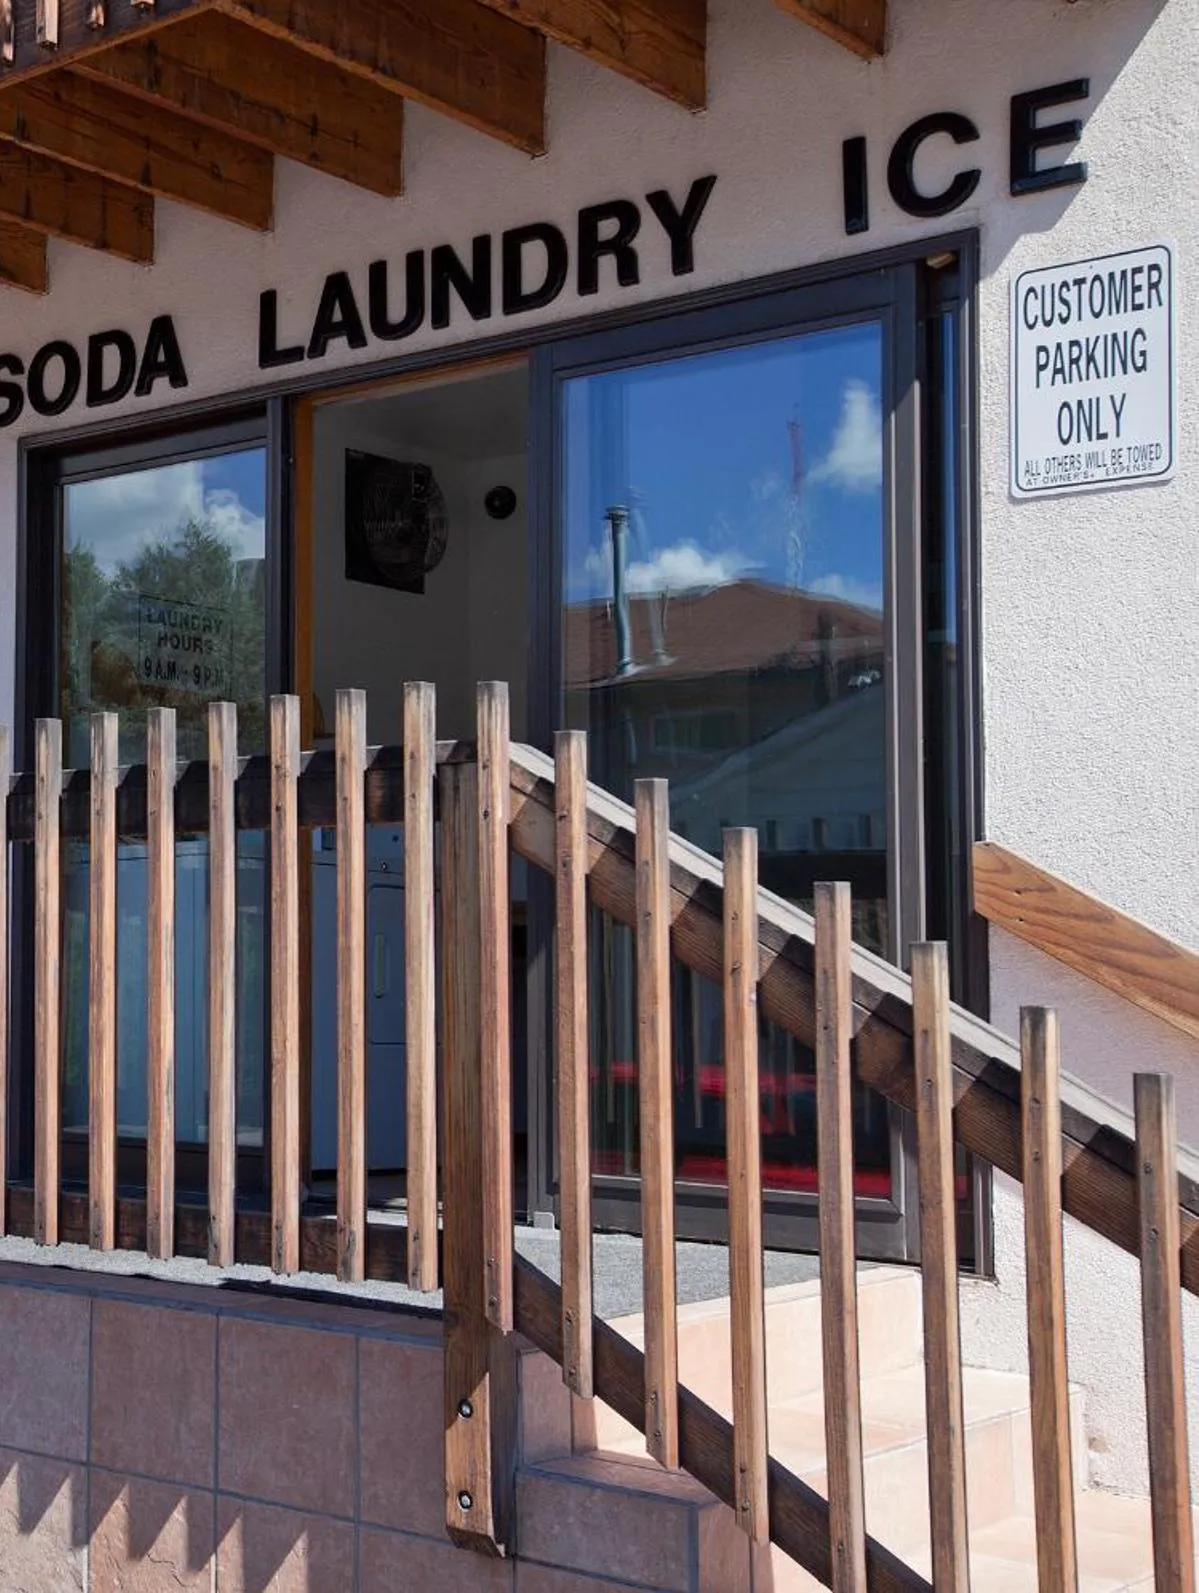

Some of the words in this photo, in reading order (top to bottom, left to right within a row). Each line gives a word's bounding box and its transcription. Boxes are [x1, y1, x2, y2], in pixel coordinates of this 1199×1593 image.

[257, 174, 717, 368] LAUNDRY
[843, 77, 1090, 234] ICE
[1023, 263, 1163, 330] CUSTOMER
[1035, 328, 1147, 388] PARKING
[1057, 393, 1126, 446] ONLY
[1024, 460, 1041, 477] ALL
[1044, 453, 1082, 475] OTHERS
[1085, 449, 1107, 469] WILL
[1111, 448, 1123, 466] BE
[1127, 443, 1162, 463] TOWED
[1025, 477, 1038, 487] AT
[147, 607, 223, 634] LAUNDRY
[157, 631, 213, 655] HOURS
[144, 656, 153, 678] 9
[193, 664, 201, 685] 9
